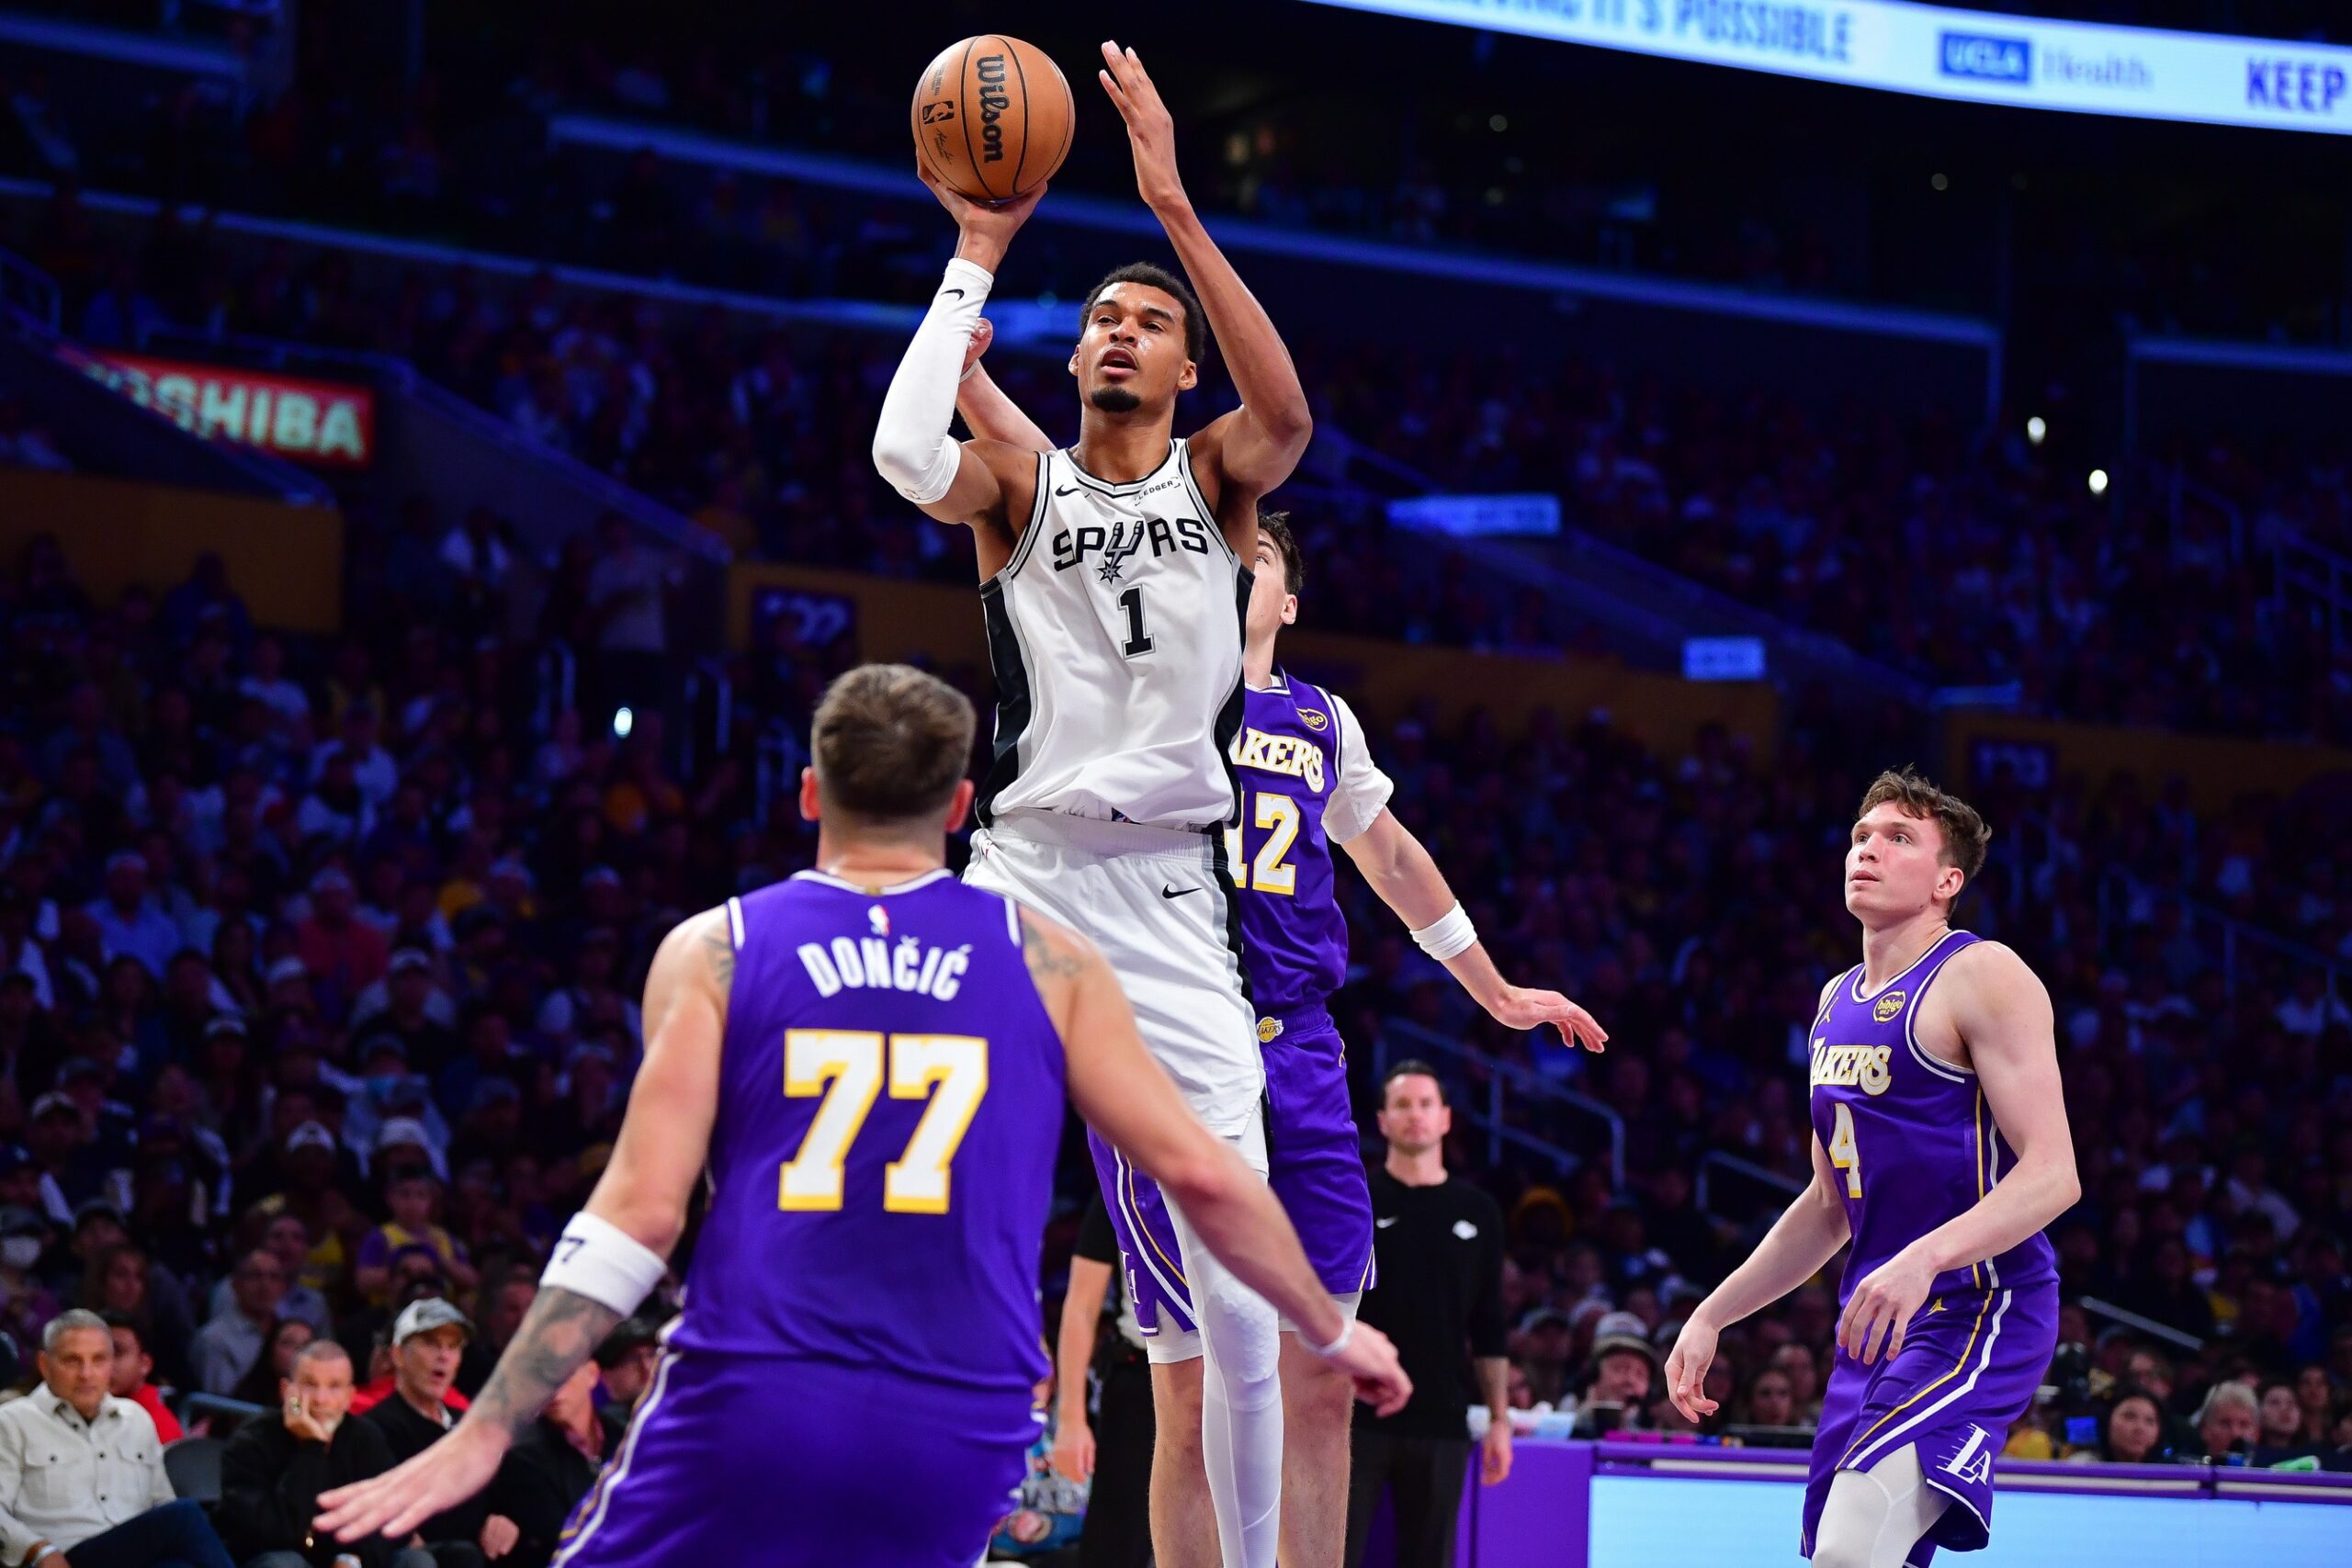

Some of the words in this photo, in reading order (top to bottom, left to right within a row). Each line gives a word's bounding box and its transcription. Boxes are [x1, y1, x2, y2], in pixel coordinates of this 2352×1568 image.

[1945, 38, 2026, 76] UCLA
[2245, 57, 2346, 112] KEEP
[977, 54, 1010, 163] Wilson
[1138, 479, 1173, 500] LEDGER
[1052, 517, 1209, 575] SPURS
[1117, 583, 1156, 660] 1
[797, 935, 973, 1001] DONČIĆ
[778, 1029, 989, 1214] 77
[1828, 1102, 1862, 1198] 4
[1936, 1423, 1991, 1485] LA
